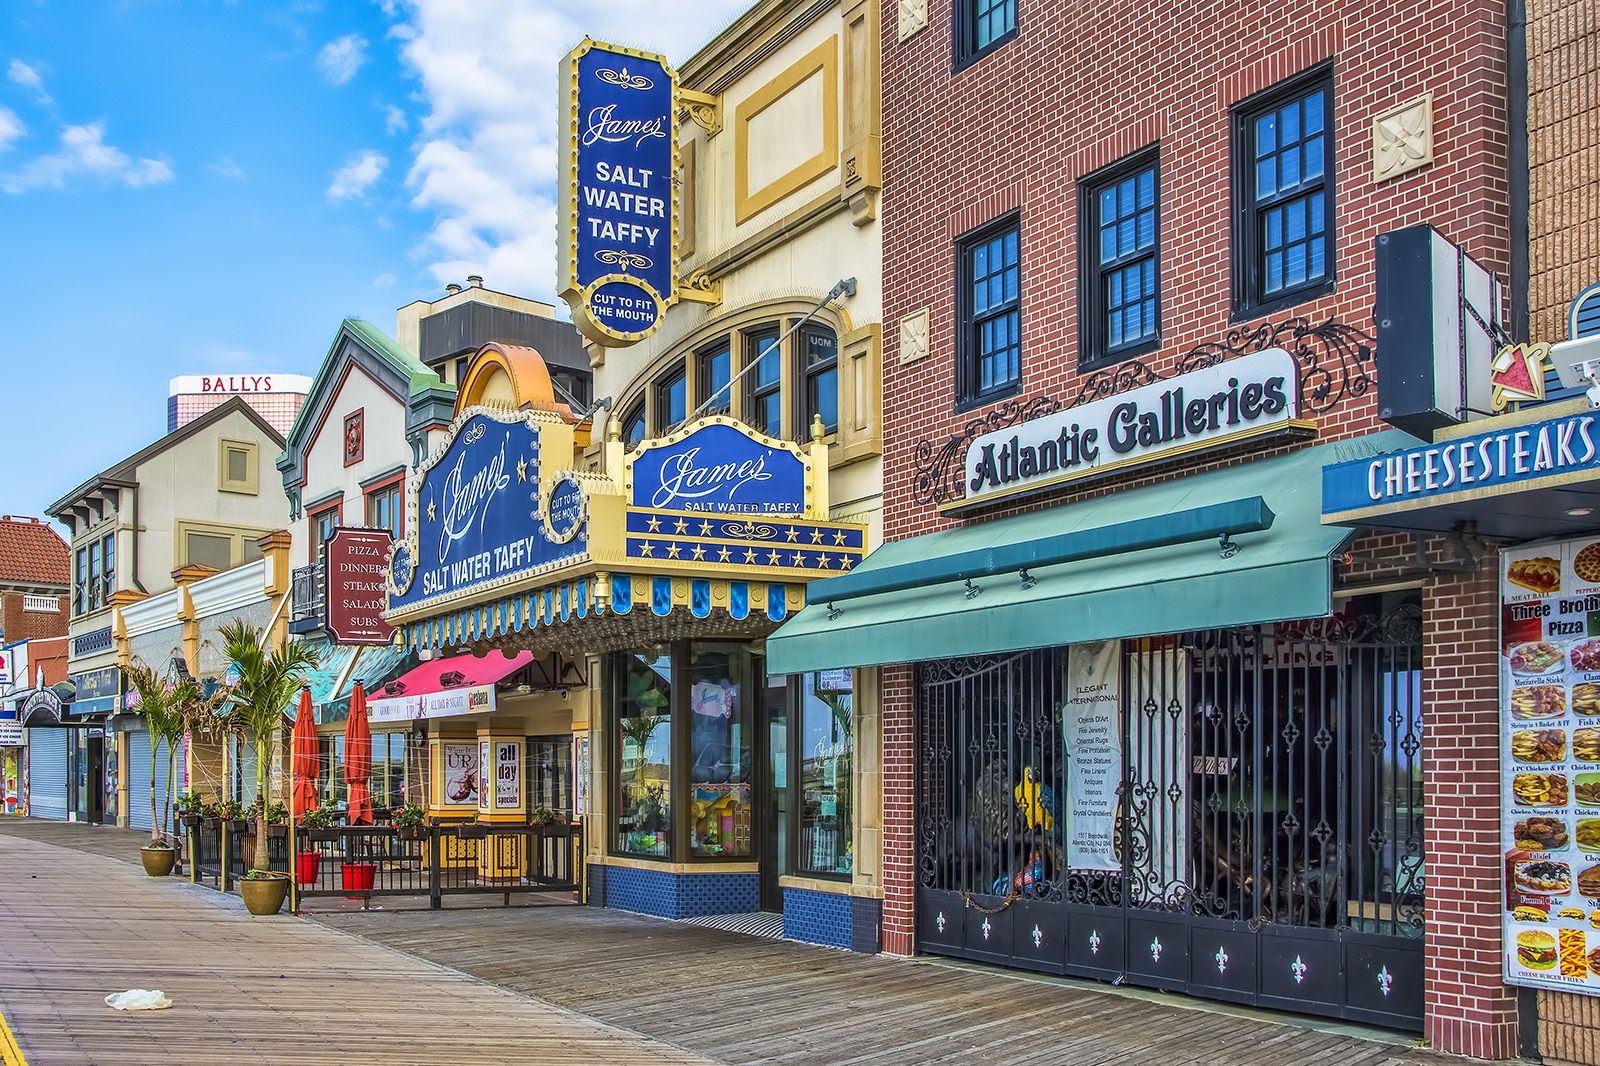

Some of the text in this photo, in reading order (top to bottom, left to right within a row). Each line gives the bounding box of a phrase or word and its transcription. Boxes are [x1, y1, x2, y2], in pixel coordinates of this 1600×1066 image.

[582, 104, 667, 151] James'
[596, 162, 653, 188] SALT
[584, 187, 665, 218] WATER
[588, 218, 660, 247] TAFFY
[594, 293, 652, 310] CUT TO FIT
[592, 305, 654, 322] THE MOUTH
[202, 376, 271, 392] BALLYS
[970, 376, 1287, 492] Atlantic Galleries
[1368, 417, 1596, 500] CHEESESTEAKS
[651, 447, 773, 509] James'
[552, 498, 563, 510] CUT
[564, 494, 571, 505] TO
[684, 502, 800, 513] SALT WATER TAFFY
[348, 546, 379, 556] PIZZA
[423, 564, 450, 596] SALT
[451, 547, 492, 587] WATER
[493, 535, 535, 574] TAFFY
[1533, 591, 1551, 599] BALL
[1512, 604, 1551, 621] Three
[351, 617, 378, 627] SUBS
[1549, 621, 1584, 636] Pizza
[1514, 676, 1563, 686] Mozzarella Sticks
[1539, 720, 1555, 728] Basket
[1578, 719, 1594, 727] Fish
[1096, 737, 1109, 745] Rugs
[500, 745, 515, 761] all
[498, 764, 517, 782] day
[1084, 778, 1103, 786] Antiques
[1529, 852, 1551, 860] Falafel
[1521, 896, 1563, 905] Funnel Cake
[1539, 973, 1562, 981] BURGER
[1562, 975, 1585, 984] FRIES
